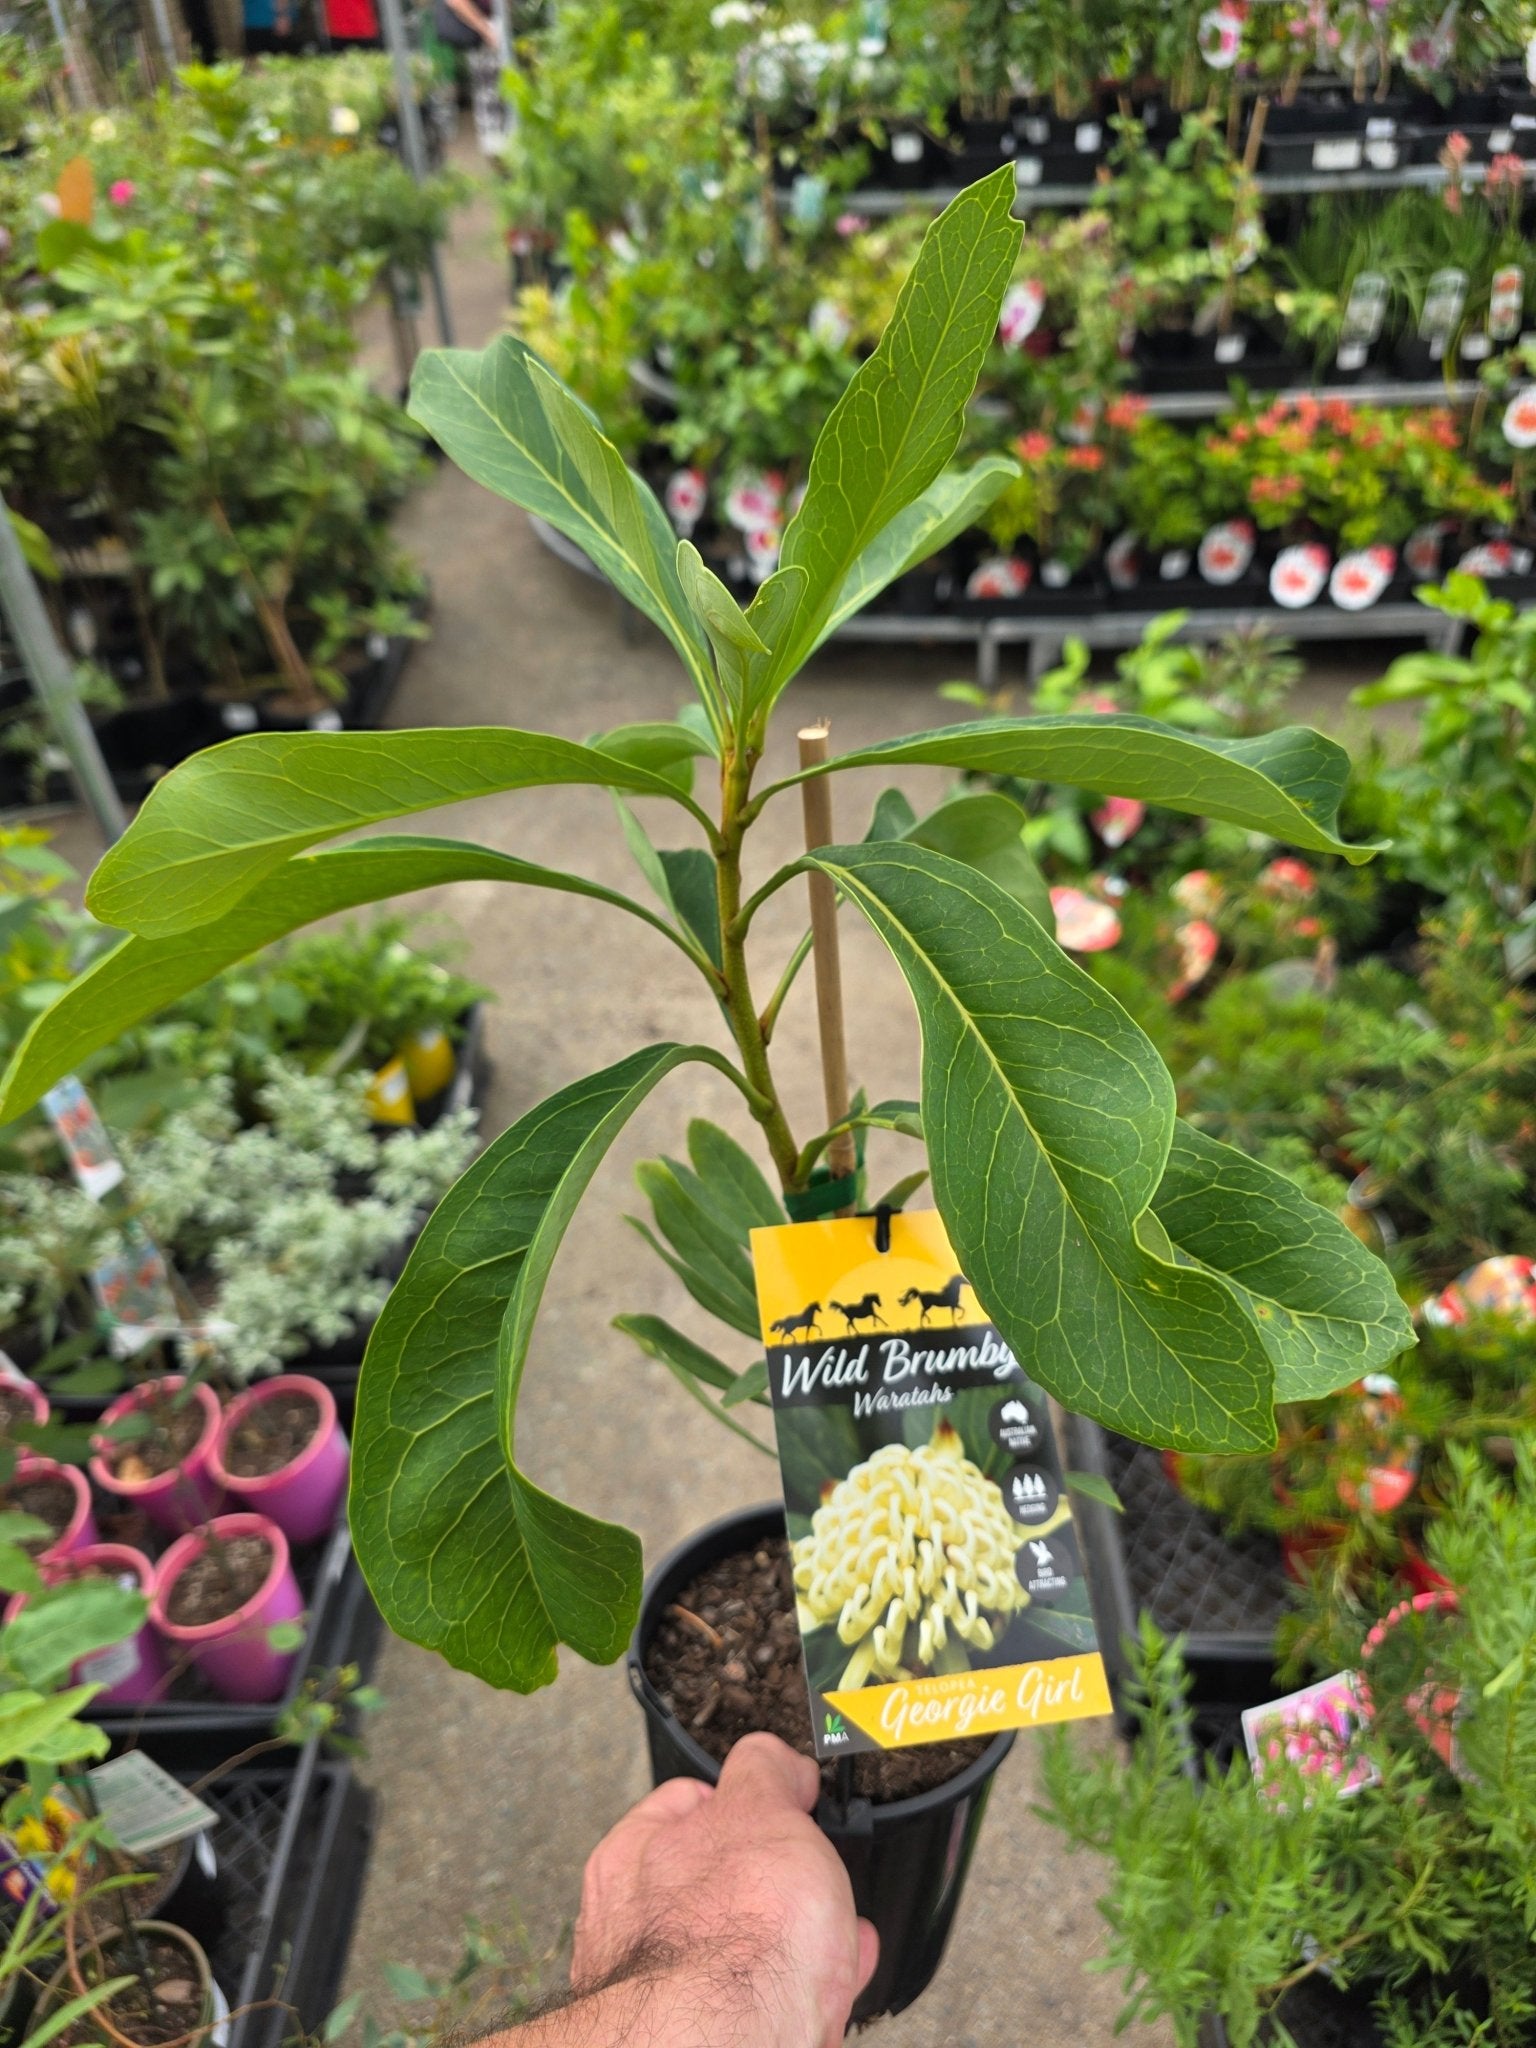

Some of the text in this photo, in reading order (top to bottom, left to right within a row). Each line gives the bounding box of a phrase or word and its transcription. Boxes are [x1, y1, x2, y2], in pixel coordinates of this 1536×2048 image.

[781, 1330, 1019, 1397] Wild Brumby
[853, 1381, 953, 1419] Waratahs
[1000, 1425, 1037, 1439] AUSTRALIAN
[1009, 1437, 1032, 1448] NATIVE
[1019, 1503, 1047, 1516] HEDGING
[1037, 1567, 1053, 1578] BIRD
[1029, 1576, 1066, 1590] ATTRACTING
[916, 1677, 977, 1696] TELOPEA
[880, 1665, 1085, 1740] Georgie Girl
[823, 1732, 850, 1746] PMA
